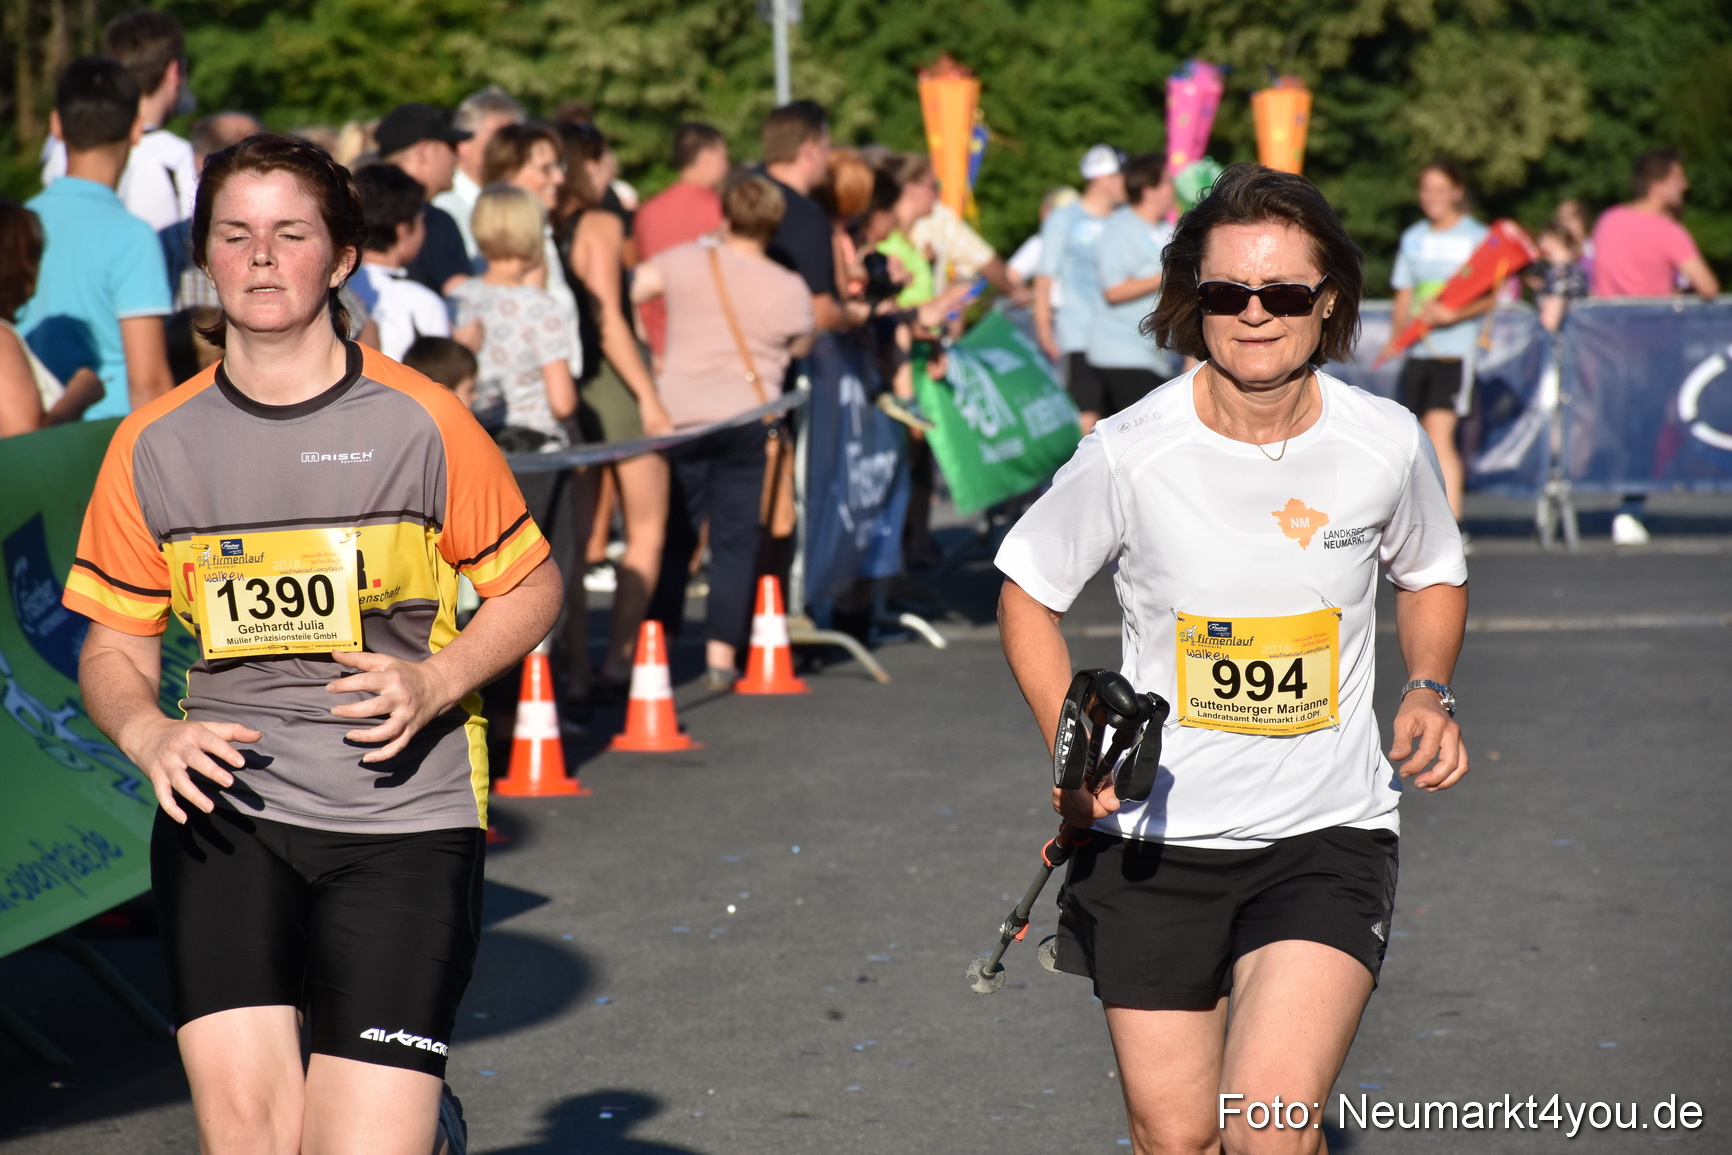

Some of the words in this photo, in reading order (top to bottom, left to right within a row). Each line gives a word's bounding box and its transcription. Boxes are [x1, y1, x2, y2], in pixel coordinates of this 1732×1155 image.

[1290, 517, 1310, 529] NM
[1323, 534, 1365, 549] NEUMARKT
[212, 552, 265, 566] firmenlauf
[272, 559, 301, 570] 2018
[203, 570, 245, 583] walken
[217, 573, 335, 622] 1390
[238, 620, 294, 635] Gebhardt
[298, 619, 324, 631] Julia
[227, 634, 252, 645] Müller
[254, 631, 312, 643] Präzisionsteile
[313, 632, 338, 641] GmbH
[1197, 633, 1255, 646] firmenlauf
[1186, 648, 1230, 661] walken
[1261, 643, 1292, 654] 2018
[1212, 657, 1308, 702] 994
[1190, 697, 1273, 716] Guttenberger
[1277, 697, 1328, 714] Marianne
[1197, 710, 1250, 723] Landratsamt
[1251, 715, 1294, 724] Neumarkt
